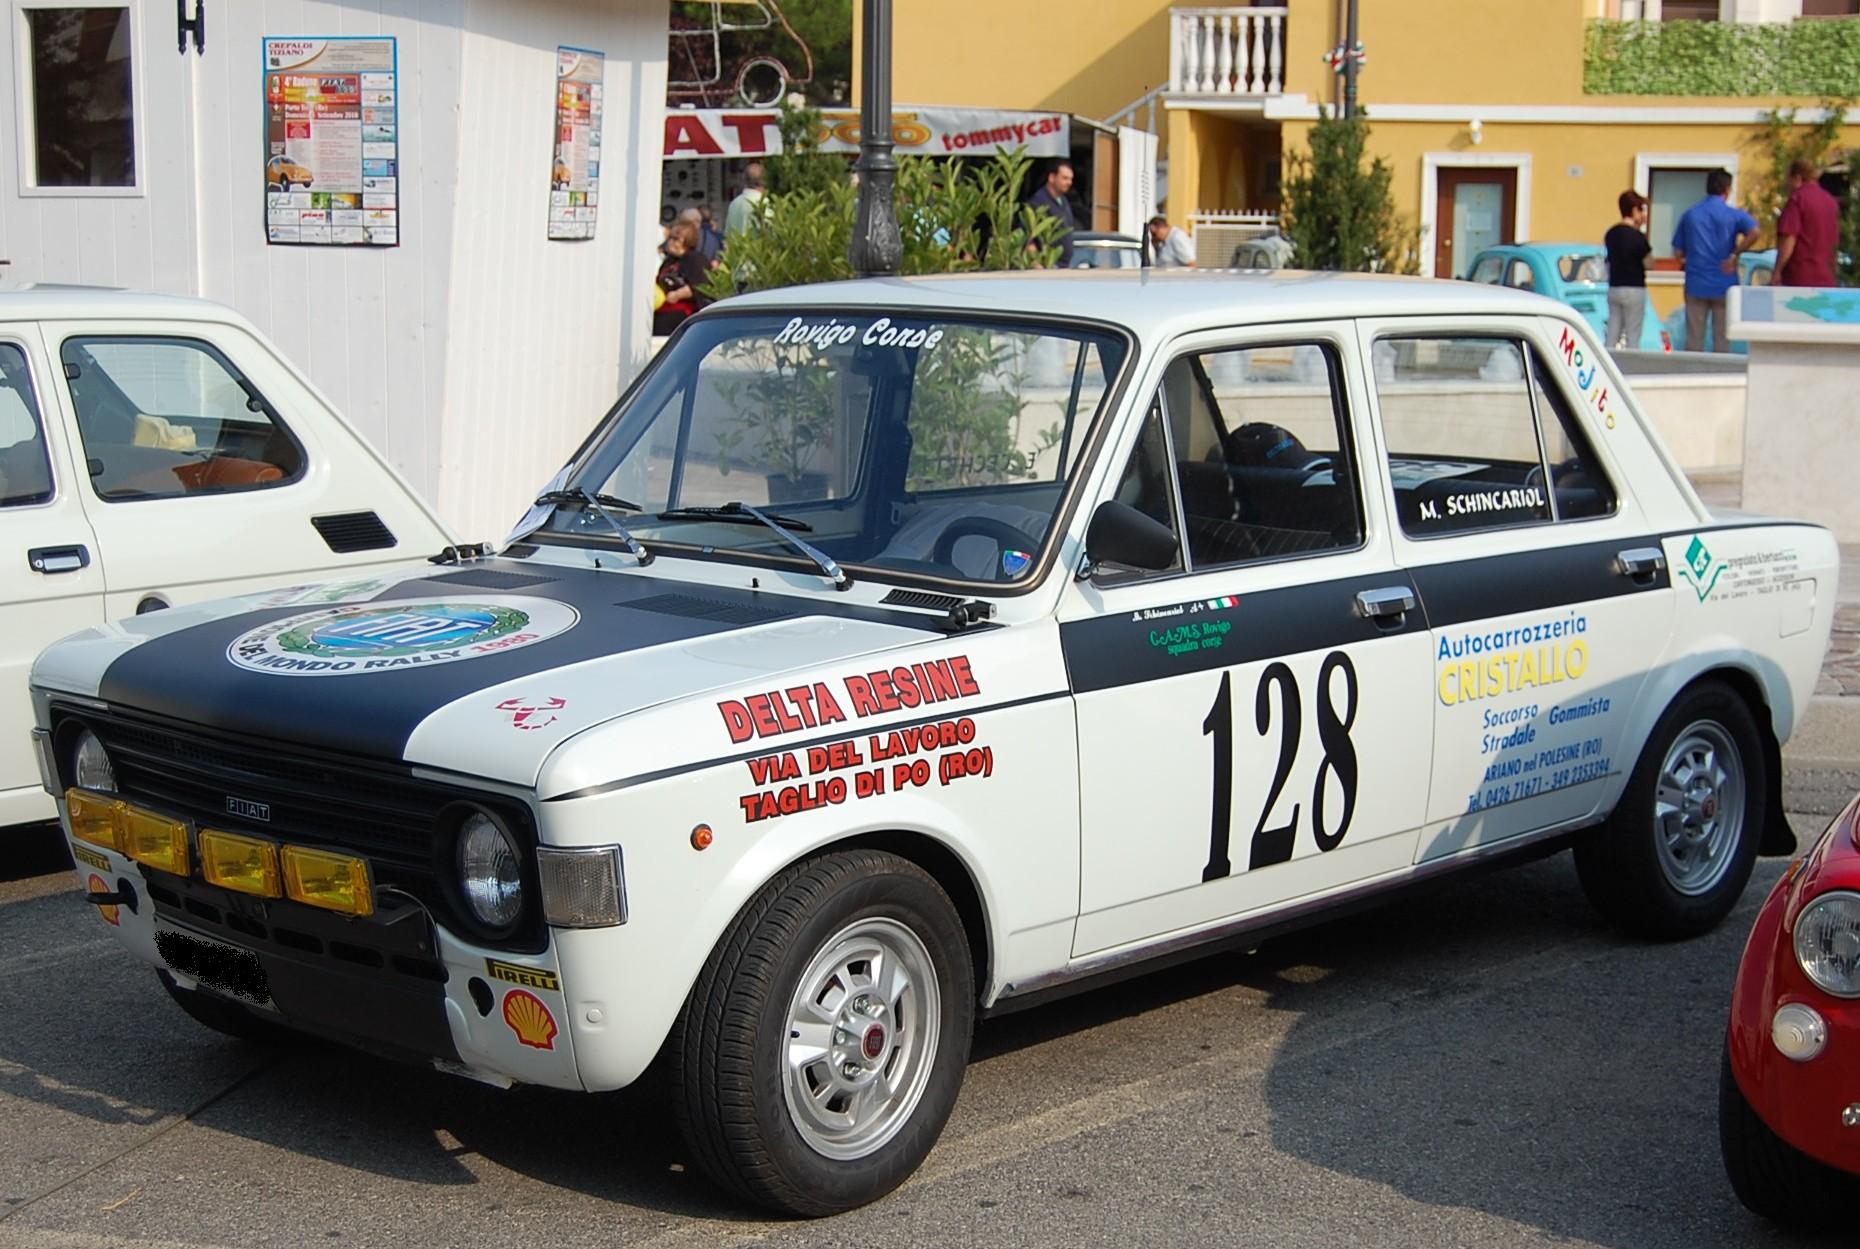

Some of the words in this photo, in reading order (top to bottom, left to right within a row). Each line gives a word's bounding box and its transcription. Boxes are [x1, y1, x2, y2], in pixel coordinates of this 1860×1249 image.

[941, 117, 1062, 151] tommycar
[772, 316, 857, 351] Rovigo
[862, 317, 944, 350] Corse
[1419, 500, 1442, 520] M.
[1446, 487, 1545, 516] SCHINCARIOL
[254, 654, 356, 672] MONDO
[363, 650, 461, 669] RALLY
[470, 632, 540, 653] 1980
[1438, 611, 1587, 660] Autocarrozzeria
[1438, 638, 1590, 706] CRISTALLO
[717, 681, 848, 744] DELTA
[843, 655, 981, 719] RESINE
[1483, 704, 1539, 729] Soccorso
[1549, 697, 1611, 726] Gommista
[747, 751, 803, 786] VIA
[806, 740, 863, 776] DEL
[868, 718, 976, 763] LAVORO
[1481, 723, 1536, 754] Stradale
[1202, 650, 1359, 884] 128
[1483, 758, 1521, 784] ARIANO
[1523, 755, 1537, 771] nel
[1539, 743, 1580, 769] POLESINE
[1581, 738, 1603, 760] (RO)
[740, 776, 848, 823] TAGLIO
[854, 771, 885, 799] DI
[893, 759, 931, 792] PO
[938, 746, 994, 787] (RO)
[1514, 778, 1542, 799] 71671
[227, 798, 269, 820] FIAT
[485, 957, 560, 992] PIRELLI
